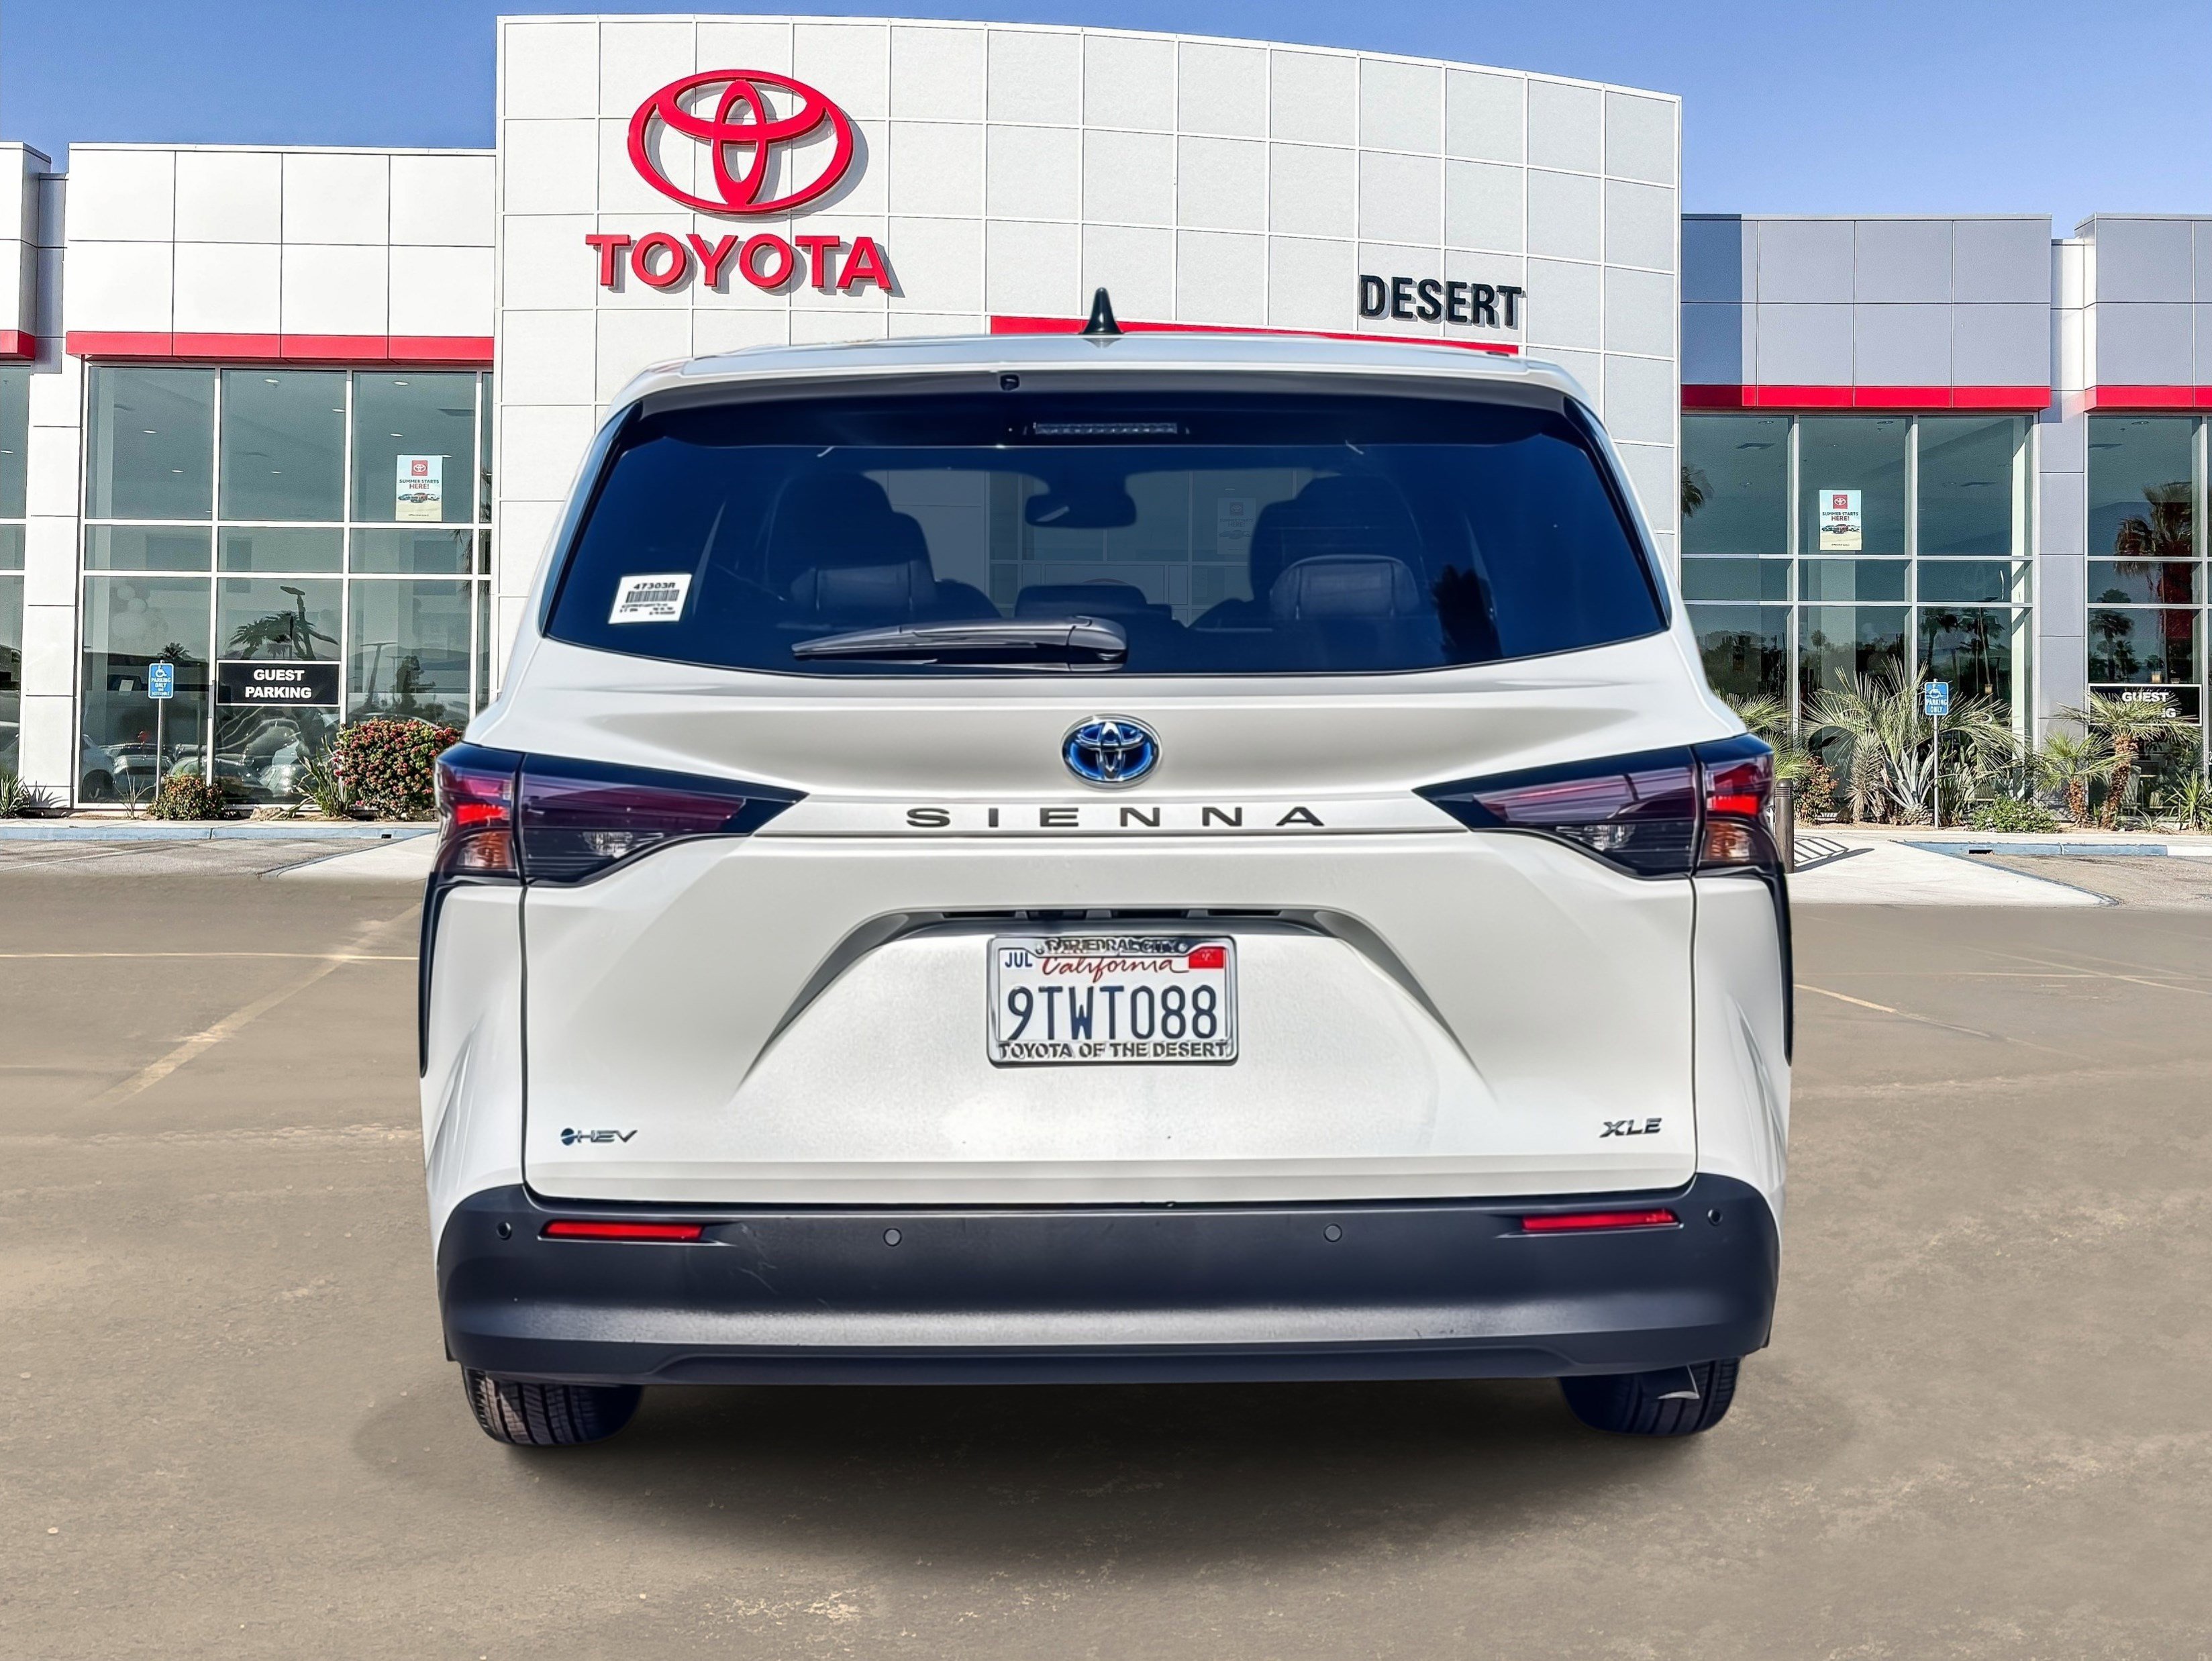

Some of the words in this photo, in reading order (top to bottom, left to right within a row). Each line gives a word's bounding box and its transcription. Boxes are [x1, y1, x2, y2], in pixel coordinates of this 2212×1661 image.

[585, 232, 893, 290] TOYOTA
[1359, 274, 1522, 327] DESERT
[254, 669, 305, 681] GUEST
[245, 686, 311, 699] PARKING
[2121, 691, 2170, 703] GUEST
[906, 807, 1325, 827] SIENNA
[1005, 952, 1033, 968] JUL
[1042, 957, 1190, 983] California
[1007, 985, 1217, 1041] 9TWT088
[999, 1043, 1072, 1058] TOYOTA
[1079, 1043, 1105, 1058] OF
[1110, 1043, 1148, 1058] THE
[1153, 1043, 1228, 1058] DESERT
[1599, 1117, 1662, 1138] XLE
